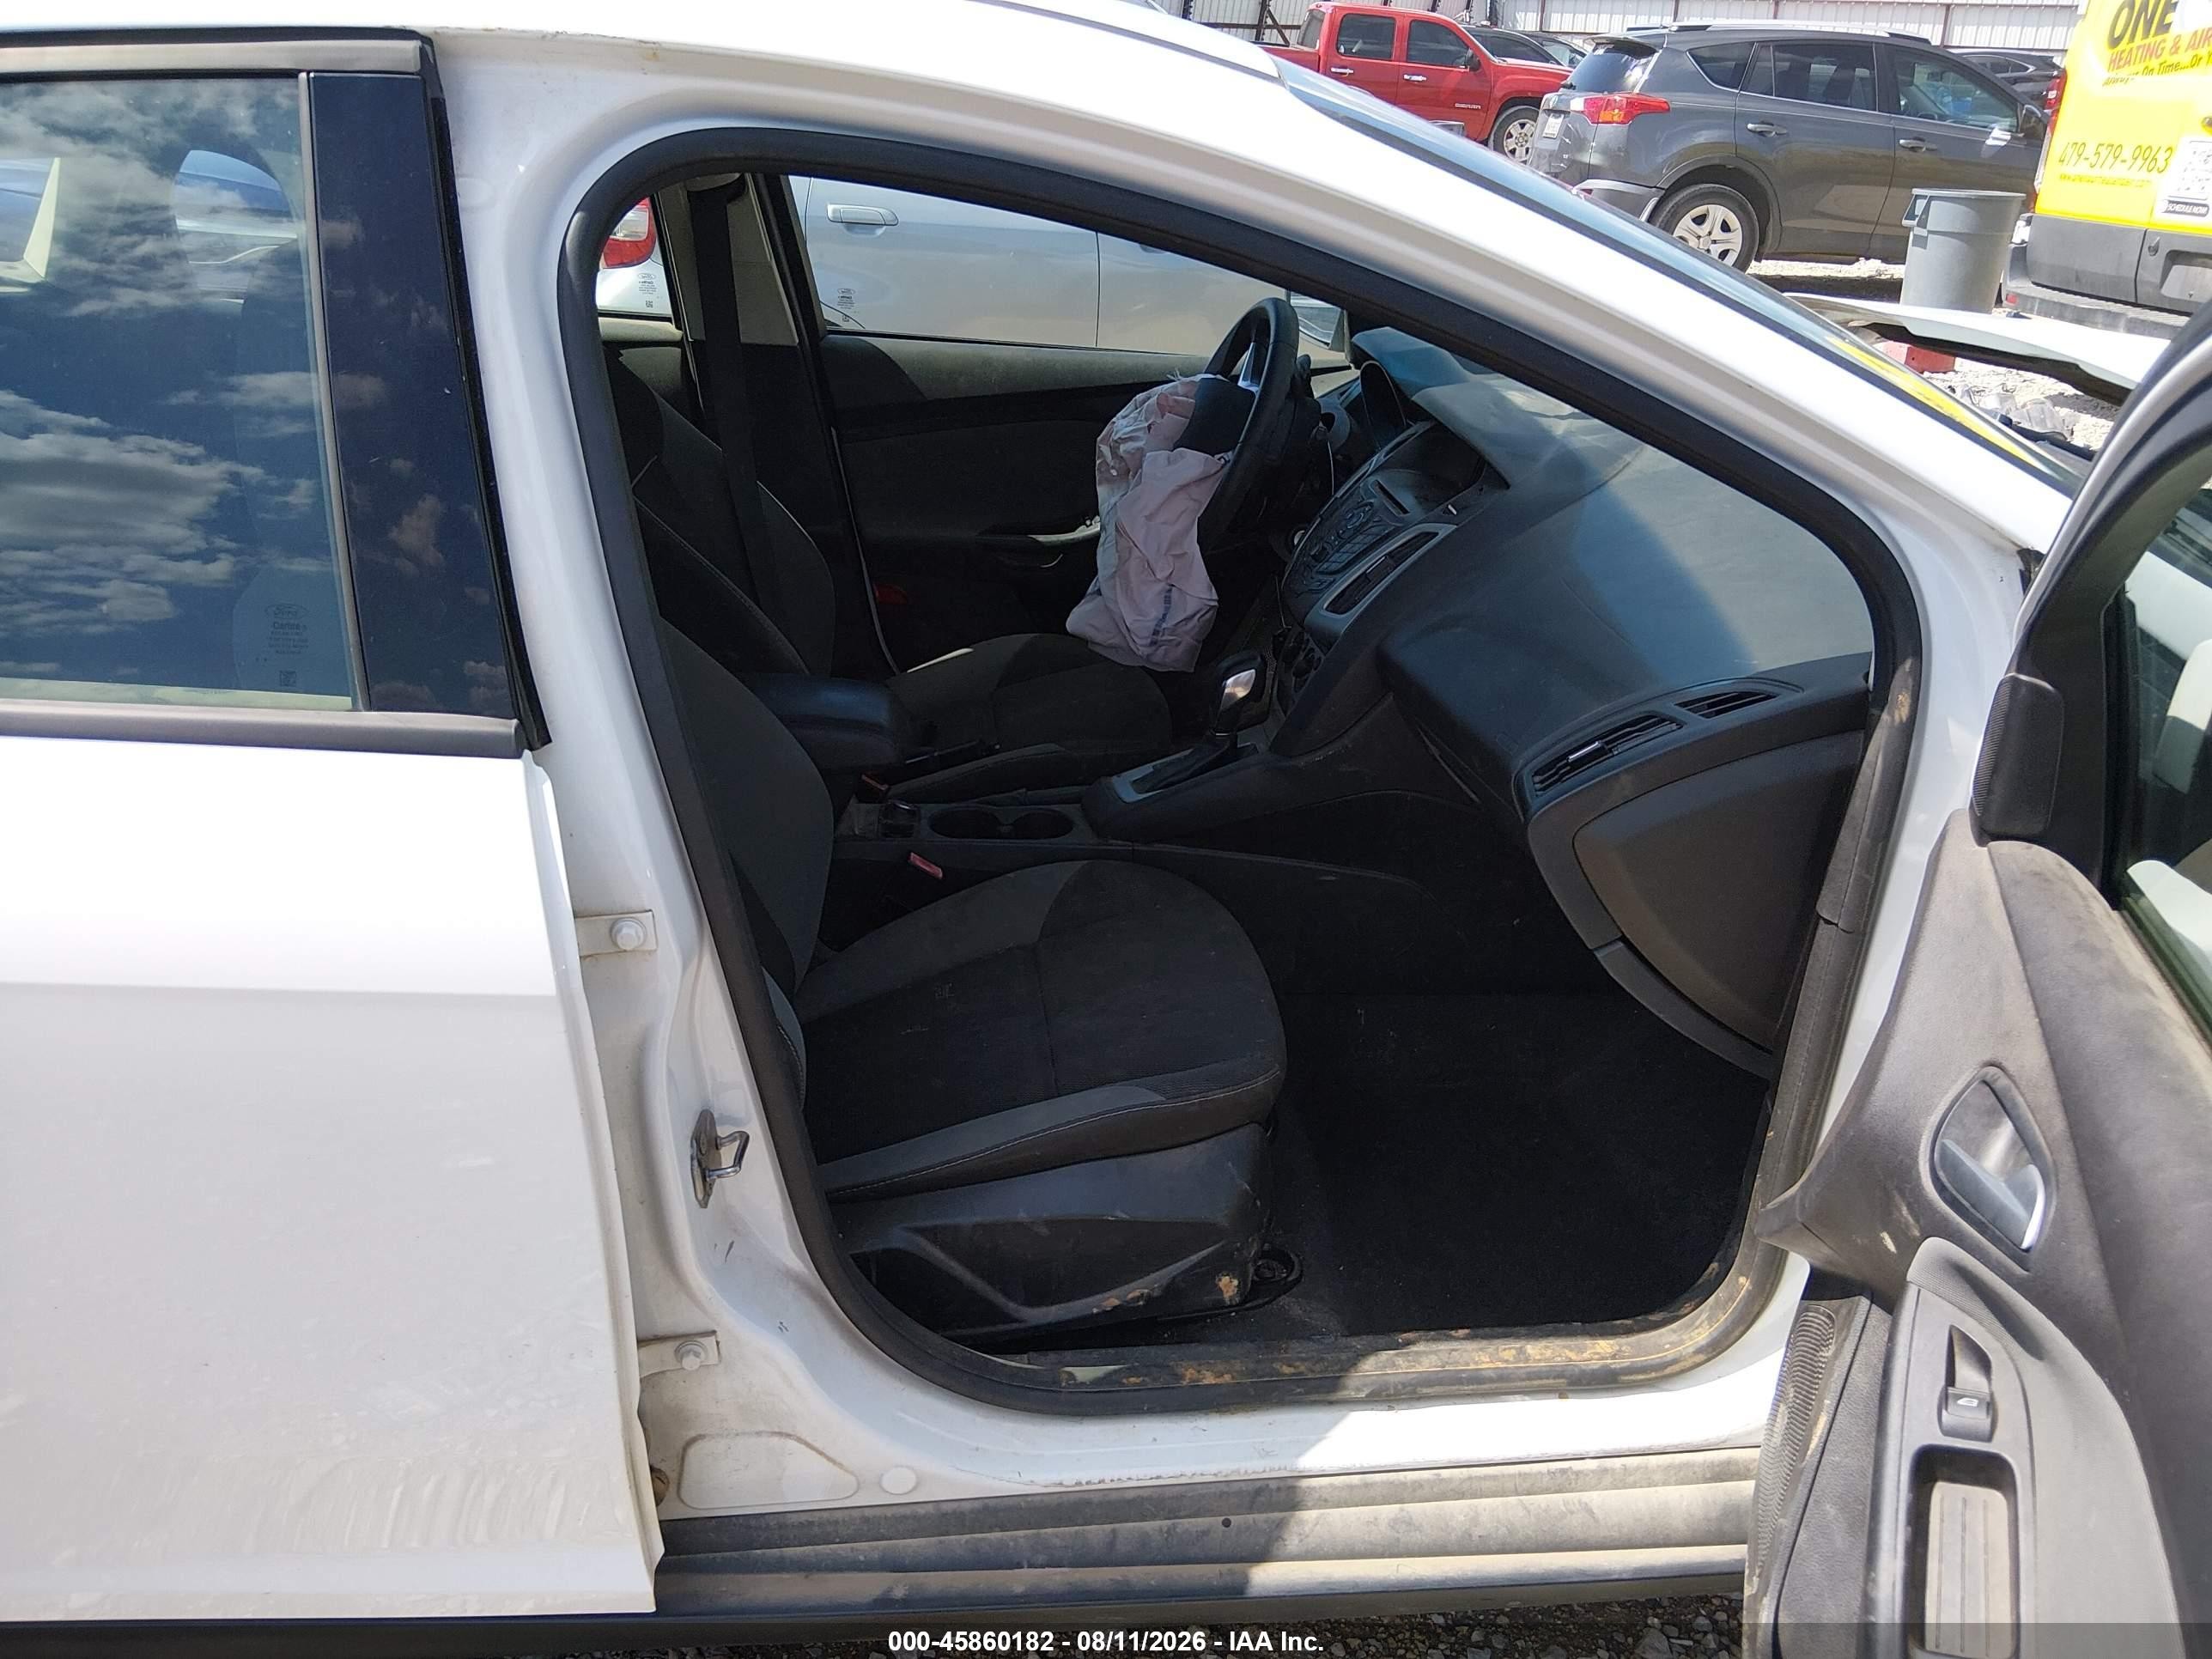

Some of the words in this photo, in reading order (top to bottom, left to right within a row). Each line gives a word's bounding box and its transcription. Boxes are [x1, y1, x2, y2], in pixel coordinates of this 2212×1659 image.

[2107, 0, 2179, 50] ONE
[2107, 38, 2167, 73] HEATING
[2169, 33, 2182, 56] &
[2057, 141, 2174, 174] 479-579-9963
